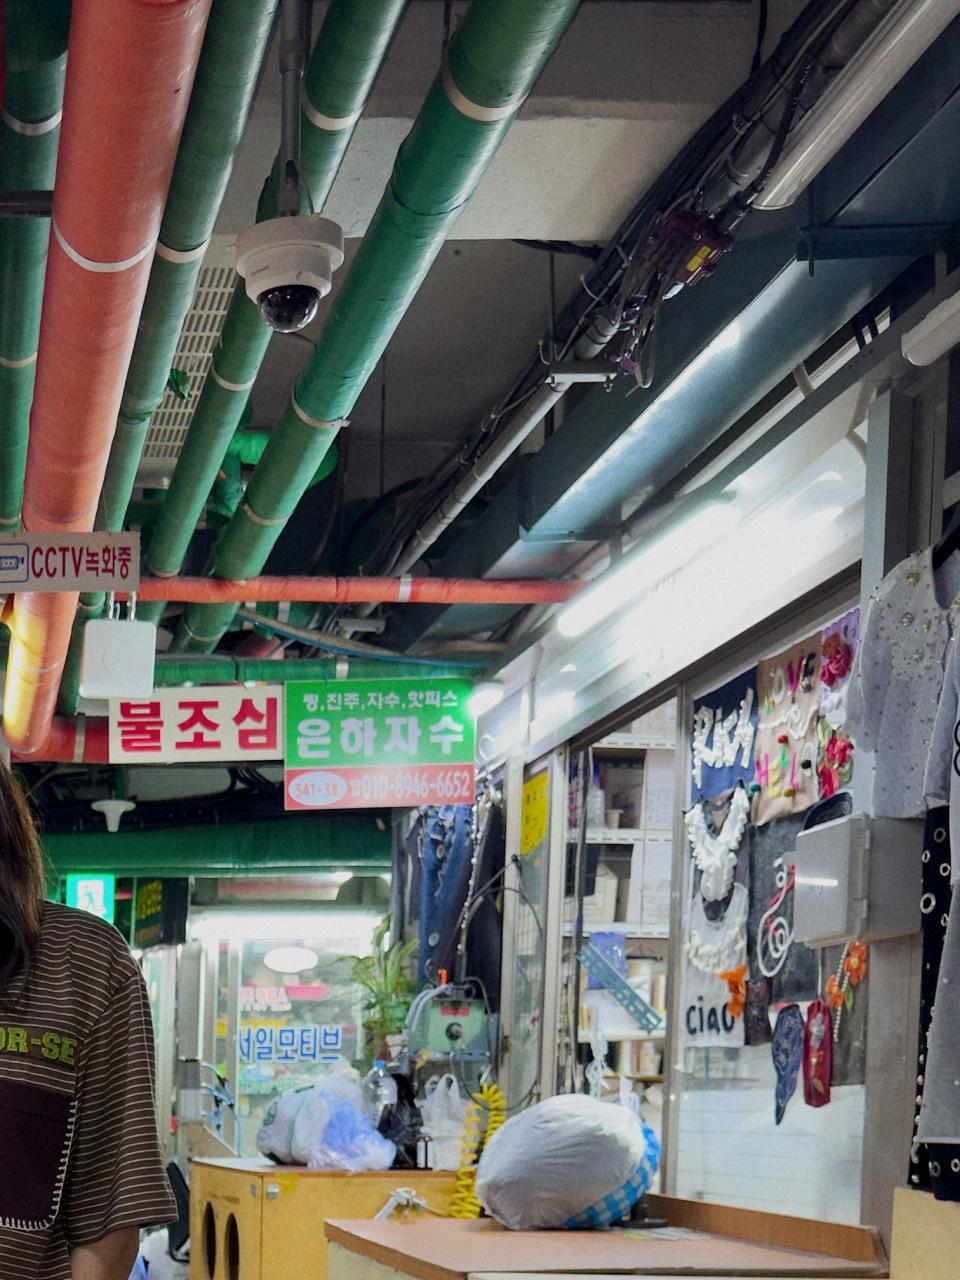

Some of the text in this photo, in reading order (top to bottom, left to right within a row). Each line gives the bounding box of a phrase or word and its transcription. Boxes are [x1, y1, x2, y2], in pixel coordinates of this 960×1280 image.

[31, 545, 132, 580] CCTV녹화중
[117, 697, 278, 753] 불조심
[297, 715, 464, 759] 은하자수
